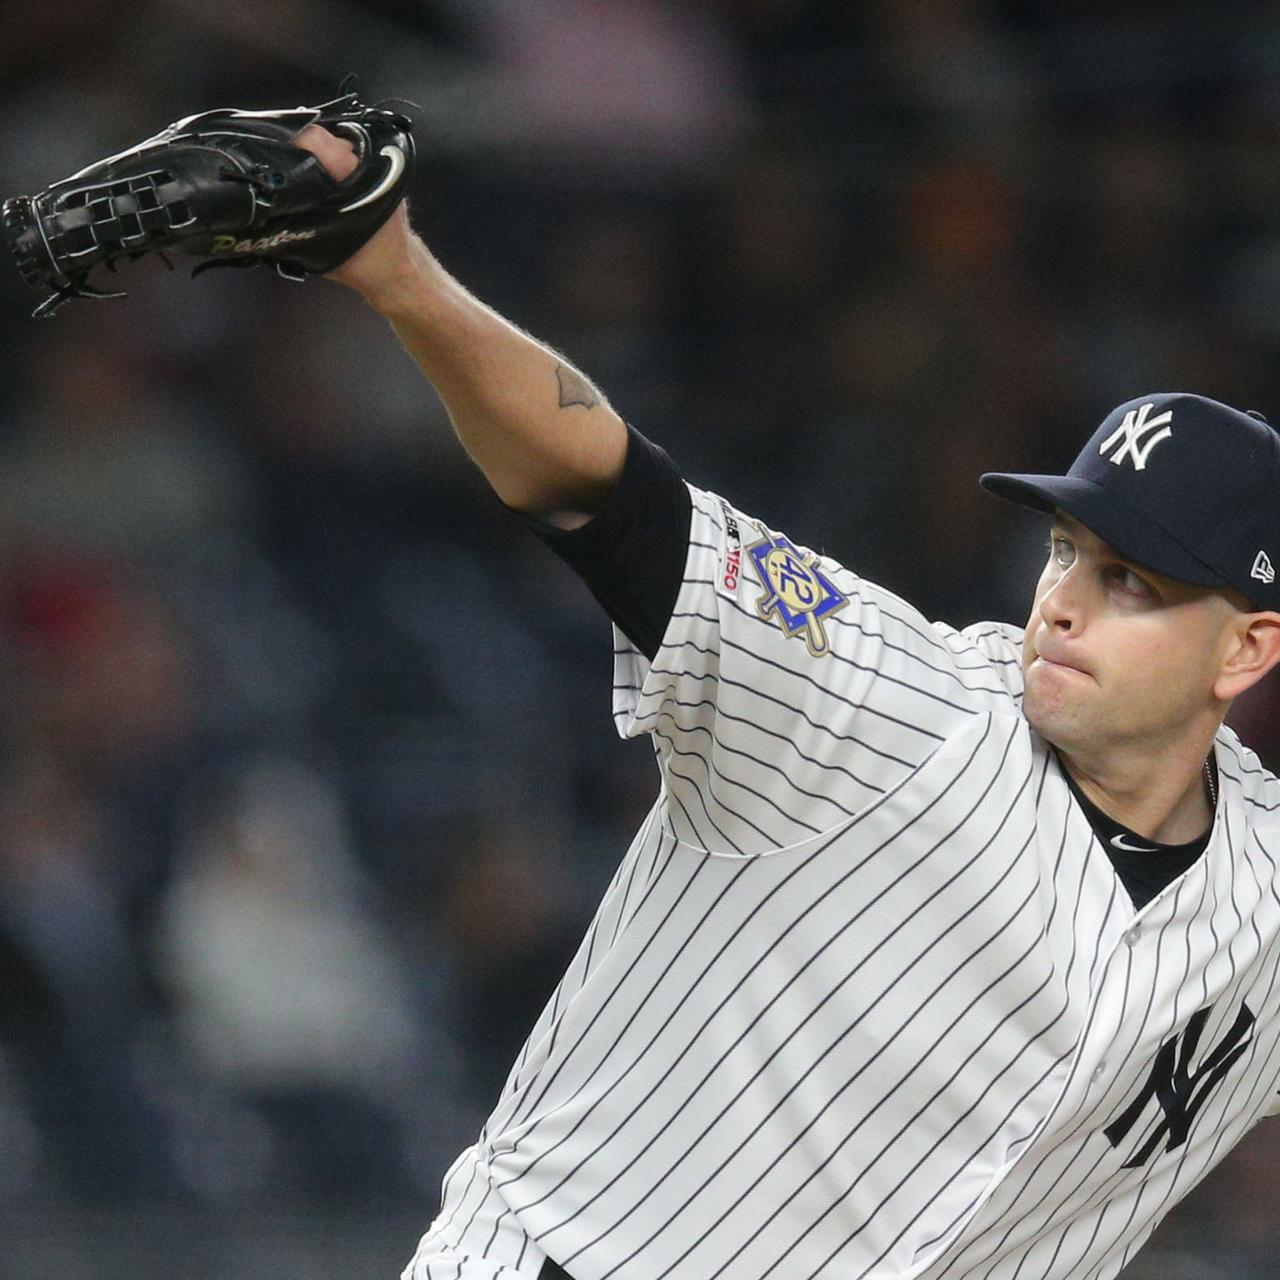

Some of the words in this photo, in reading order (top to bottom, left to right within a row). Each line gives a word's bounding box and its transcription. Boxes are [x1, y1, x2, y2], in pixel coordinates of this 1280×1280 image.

[1098, 402, 1173, 471] NY
[770, 553, 814, 605] 42
[1102, 1000, 1257, 1170] NY
